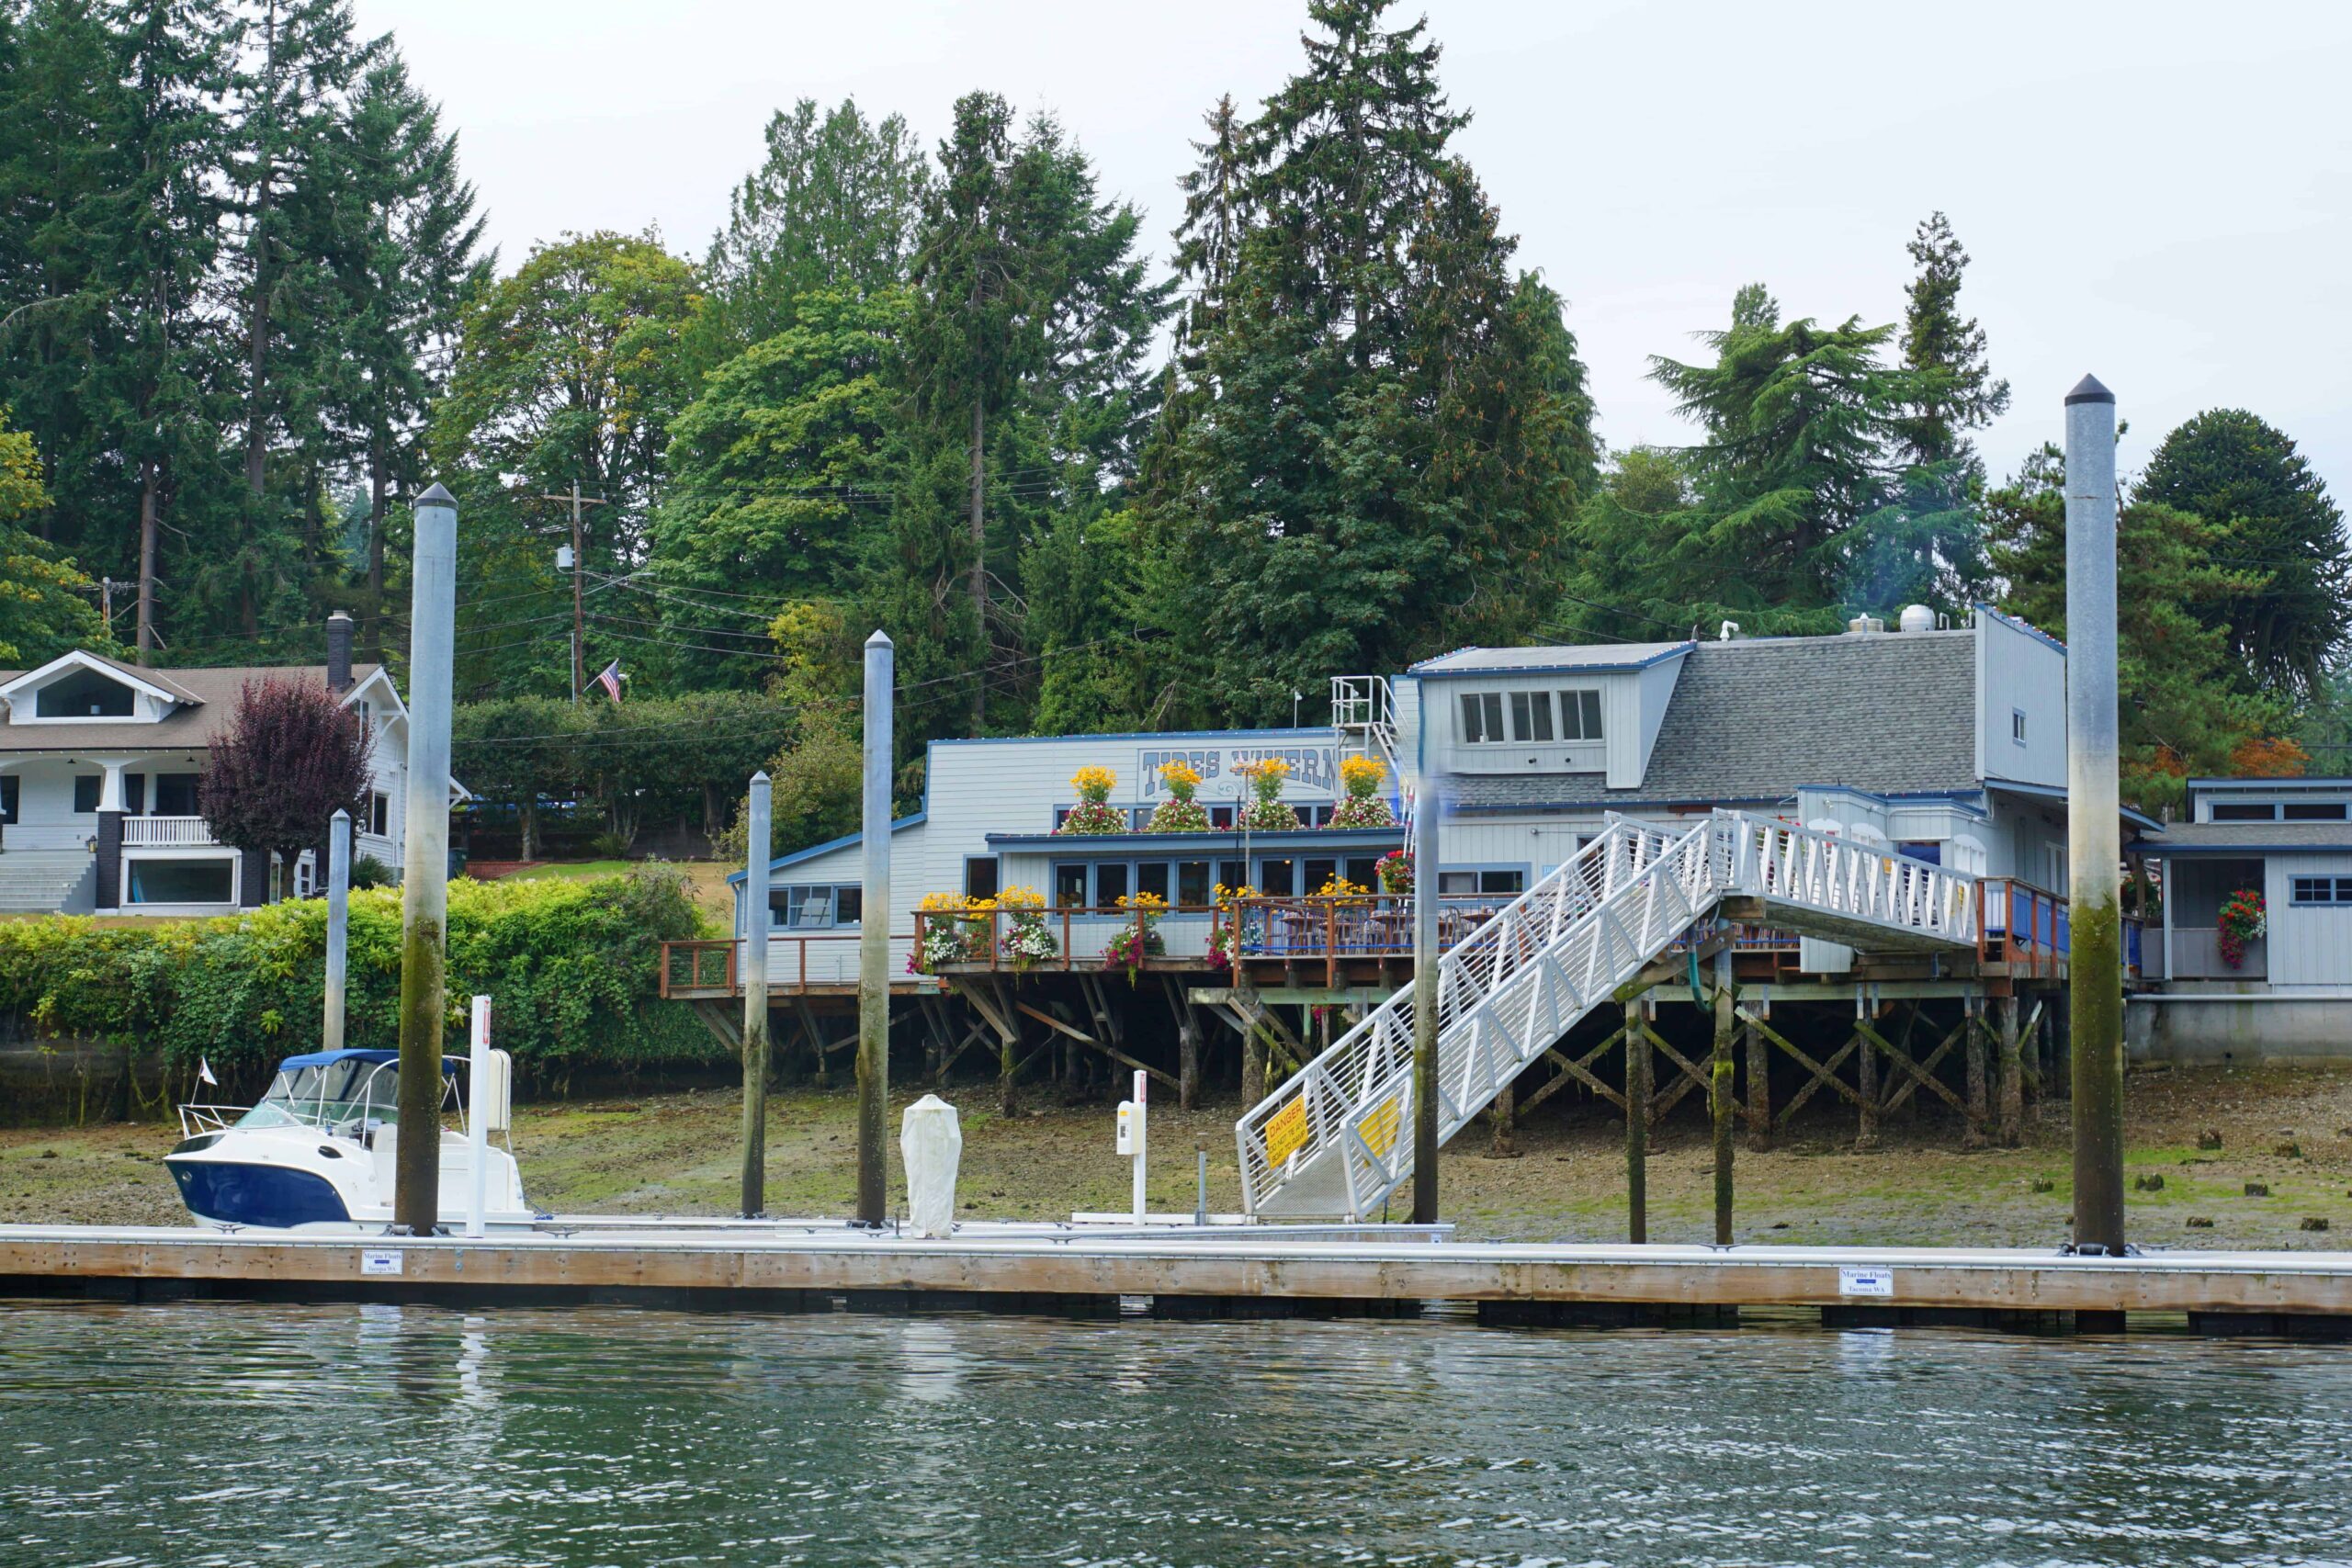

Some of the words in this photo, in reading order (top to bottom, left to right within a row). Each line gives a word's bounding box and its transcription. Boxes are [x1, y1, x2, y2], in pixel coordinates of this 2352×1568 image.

[1143, 750, 1220, 797] TIDES
[1231, 749, 1336, 792] TERN
[1270, 1103, 1302, 1138] DANGER
[1270, 1143, 1277, 1155] DO
[1278, 1134, 1287, 1146] NOT
[1272, 1147, 1284, 1164] BOAT
[1285, 1141, 1292, 1151] TO
[1293, 1129, 1306, 1145] RAMP
[1869, 1270, 1891, 1279] Floats
